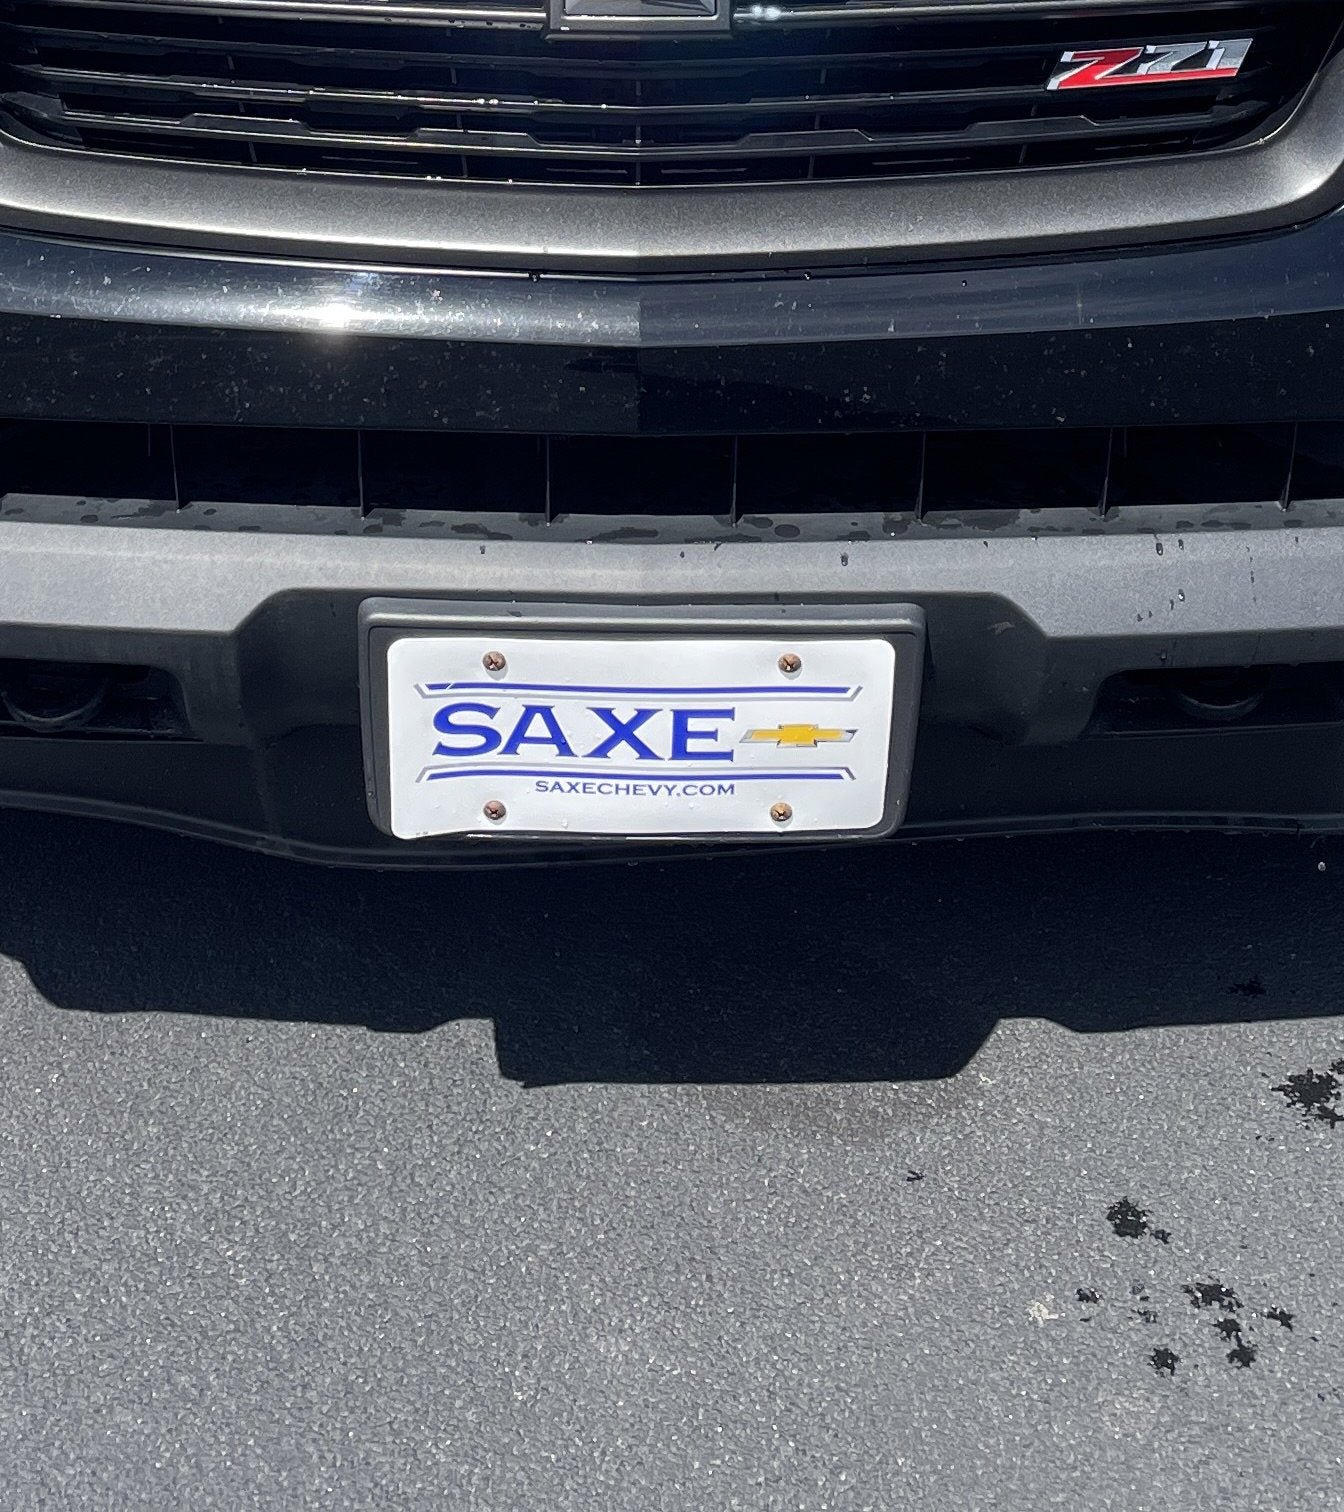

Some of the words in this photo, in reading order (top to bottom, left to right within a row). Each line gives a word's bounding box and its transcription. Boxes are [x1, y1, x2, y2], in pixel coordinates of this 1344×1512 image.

[1047, 38, 1253, 90] Z71
[432, 702, 736, 762] SAXE
[535, 780, 735, 798] SAXECHEVY.COM
